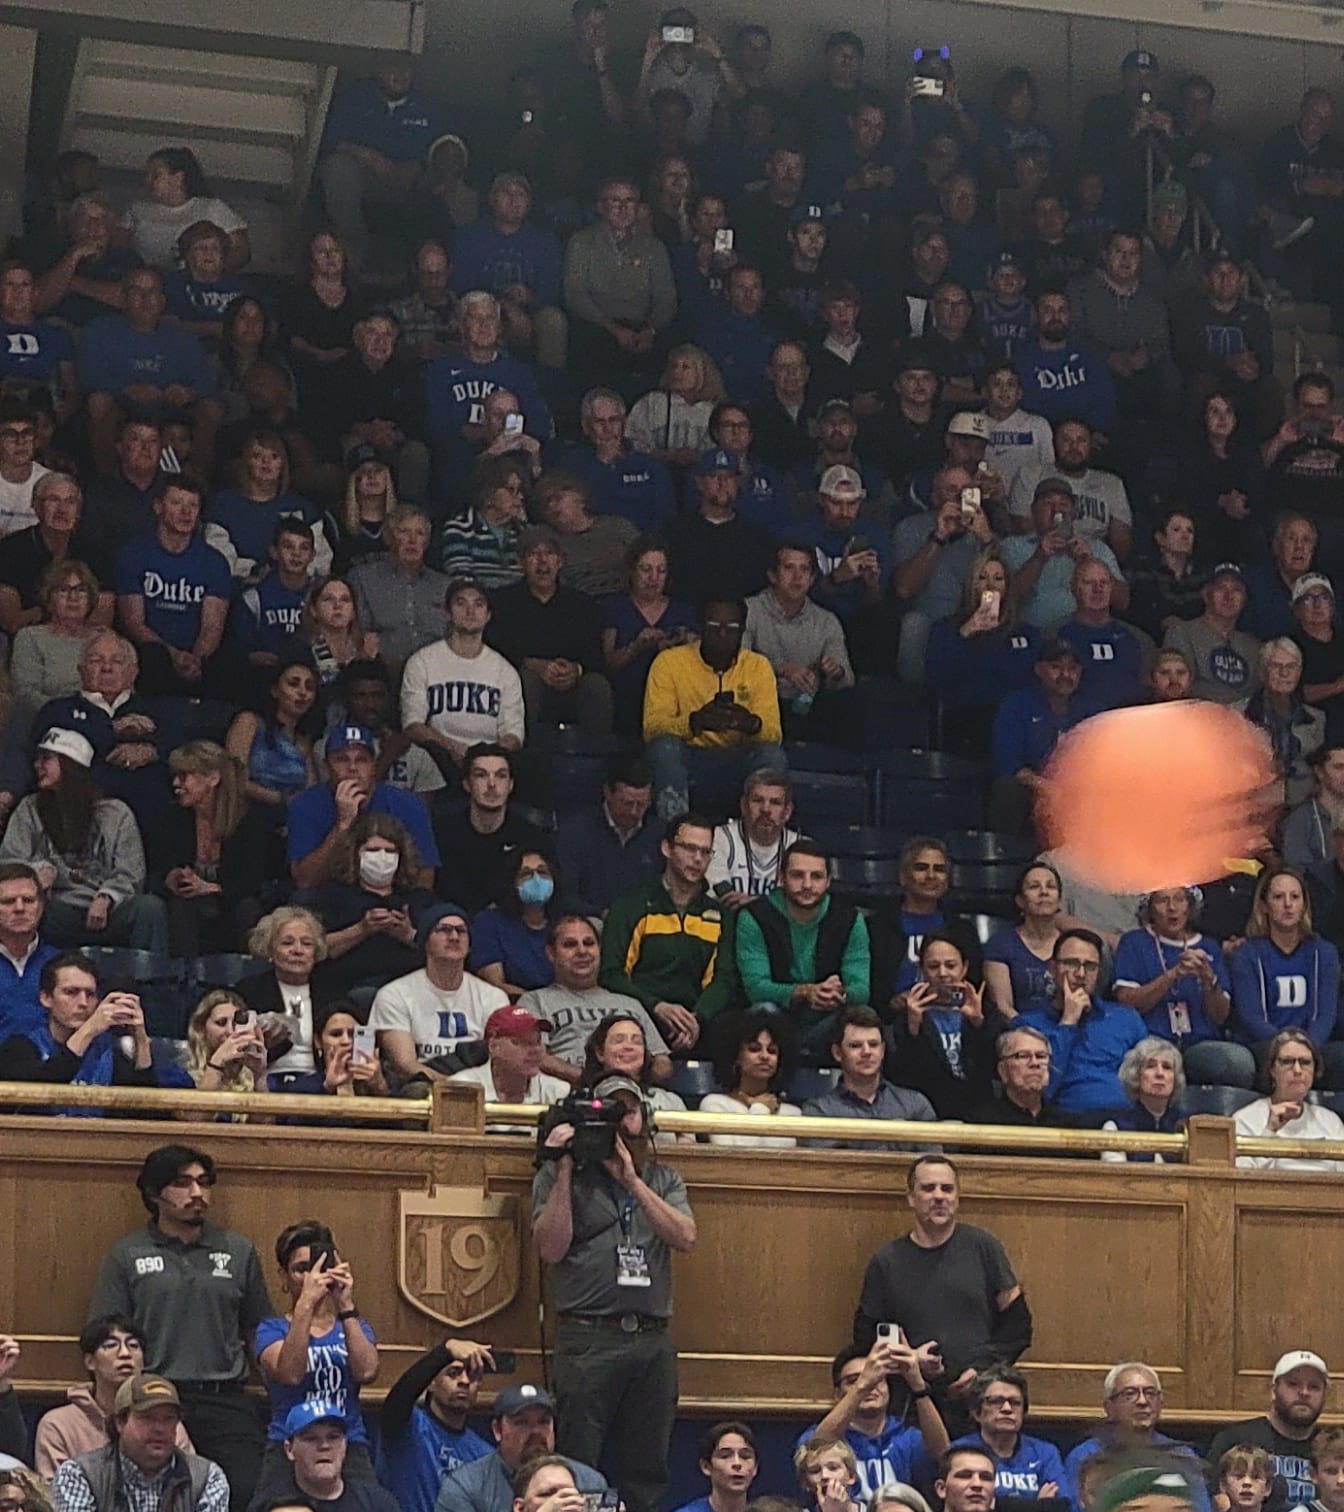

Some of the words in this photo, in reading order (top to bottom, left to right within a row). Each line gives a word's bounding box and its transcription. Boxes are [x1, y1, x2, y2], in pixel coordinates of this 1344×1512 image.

[145, 571, 205, 603] Duke
[266, 608, 303, 625] DUK
[427, 682, 502, 718] DUKE
[135, 1255, 164, 1273] 890
[422, 1223, 496, 1297] 19
